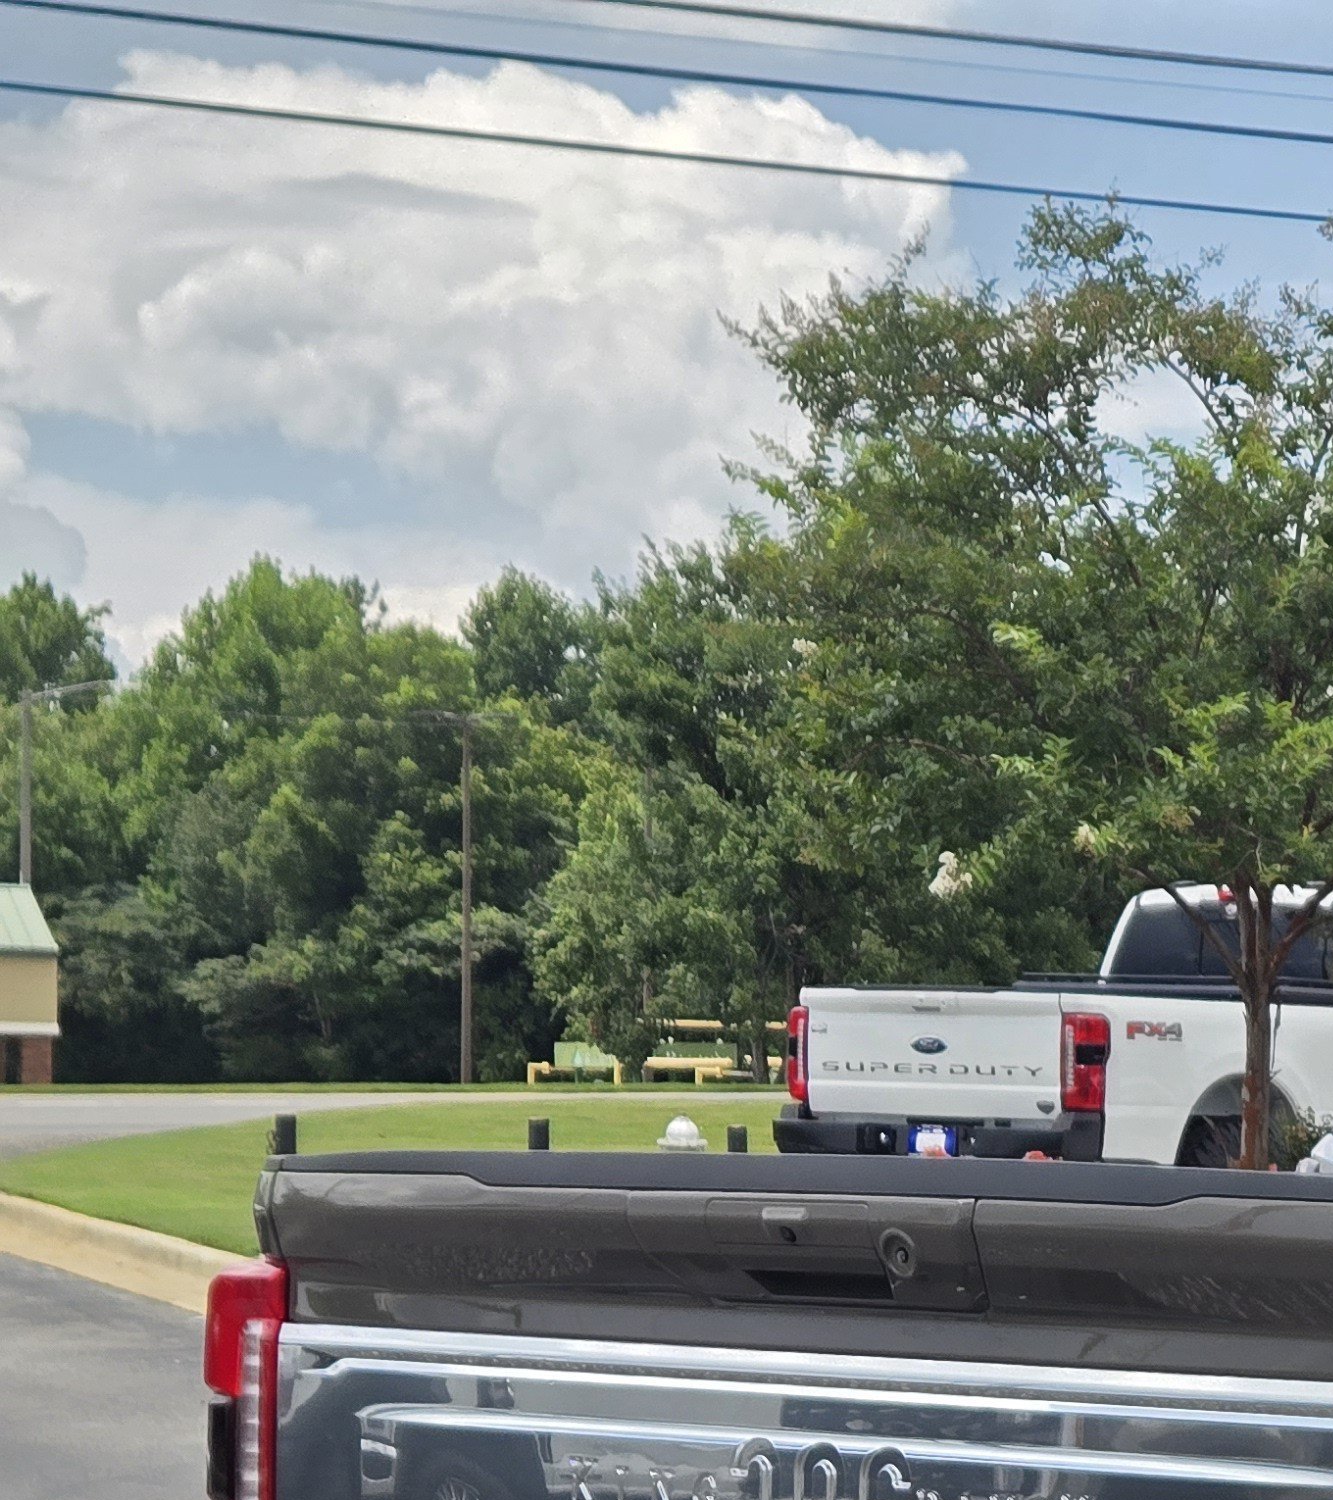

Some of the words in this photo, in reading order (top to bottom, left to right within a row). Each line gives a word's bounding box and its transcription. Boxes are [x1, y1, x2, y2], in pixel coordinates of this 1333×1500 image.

[1126, 1020, 1182, 1041] FX4
[822, 1060, 937, 1075] SUPER
[949, 1063, 1043, 1077] DUTY
